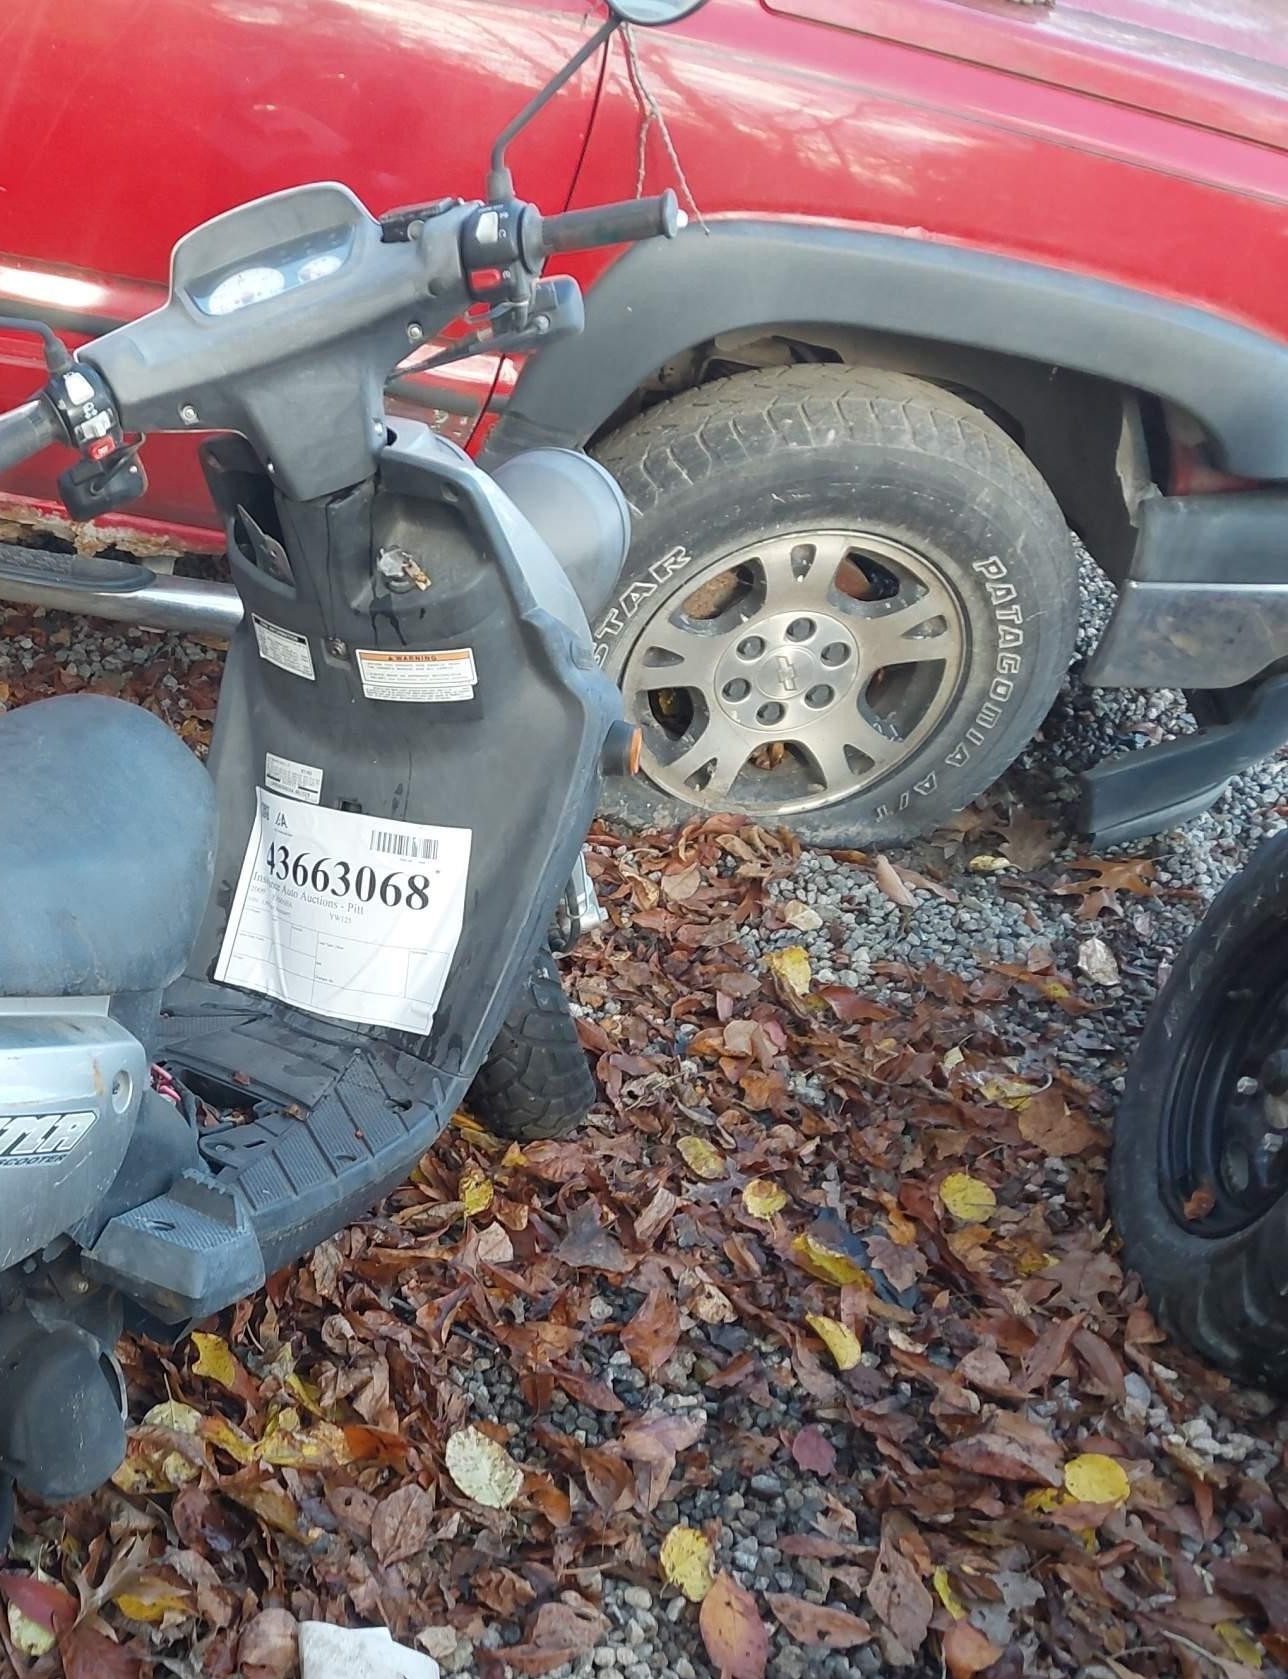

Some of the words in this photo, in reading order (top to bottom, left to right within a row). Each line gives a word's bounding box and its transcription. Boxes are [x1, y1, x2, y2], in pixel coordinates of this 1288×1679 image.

[592, 546, 692, 669] STAR
[944, 556, 1024, 768] PATAGONIA
[266, 841, 430, 911] 43663068
[281, 885, 298, 898] Auto
[300, 891, 339, 910] Auctions
